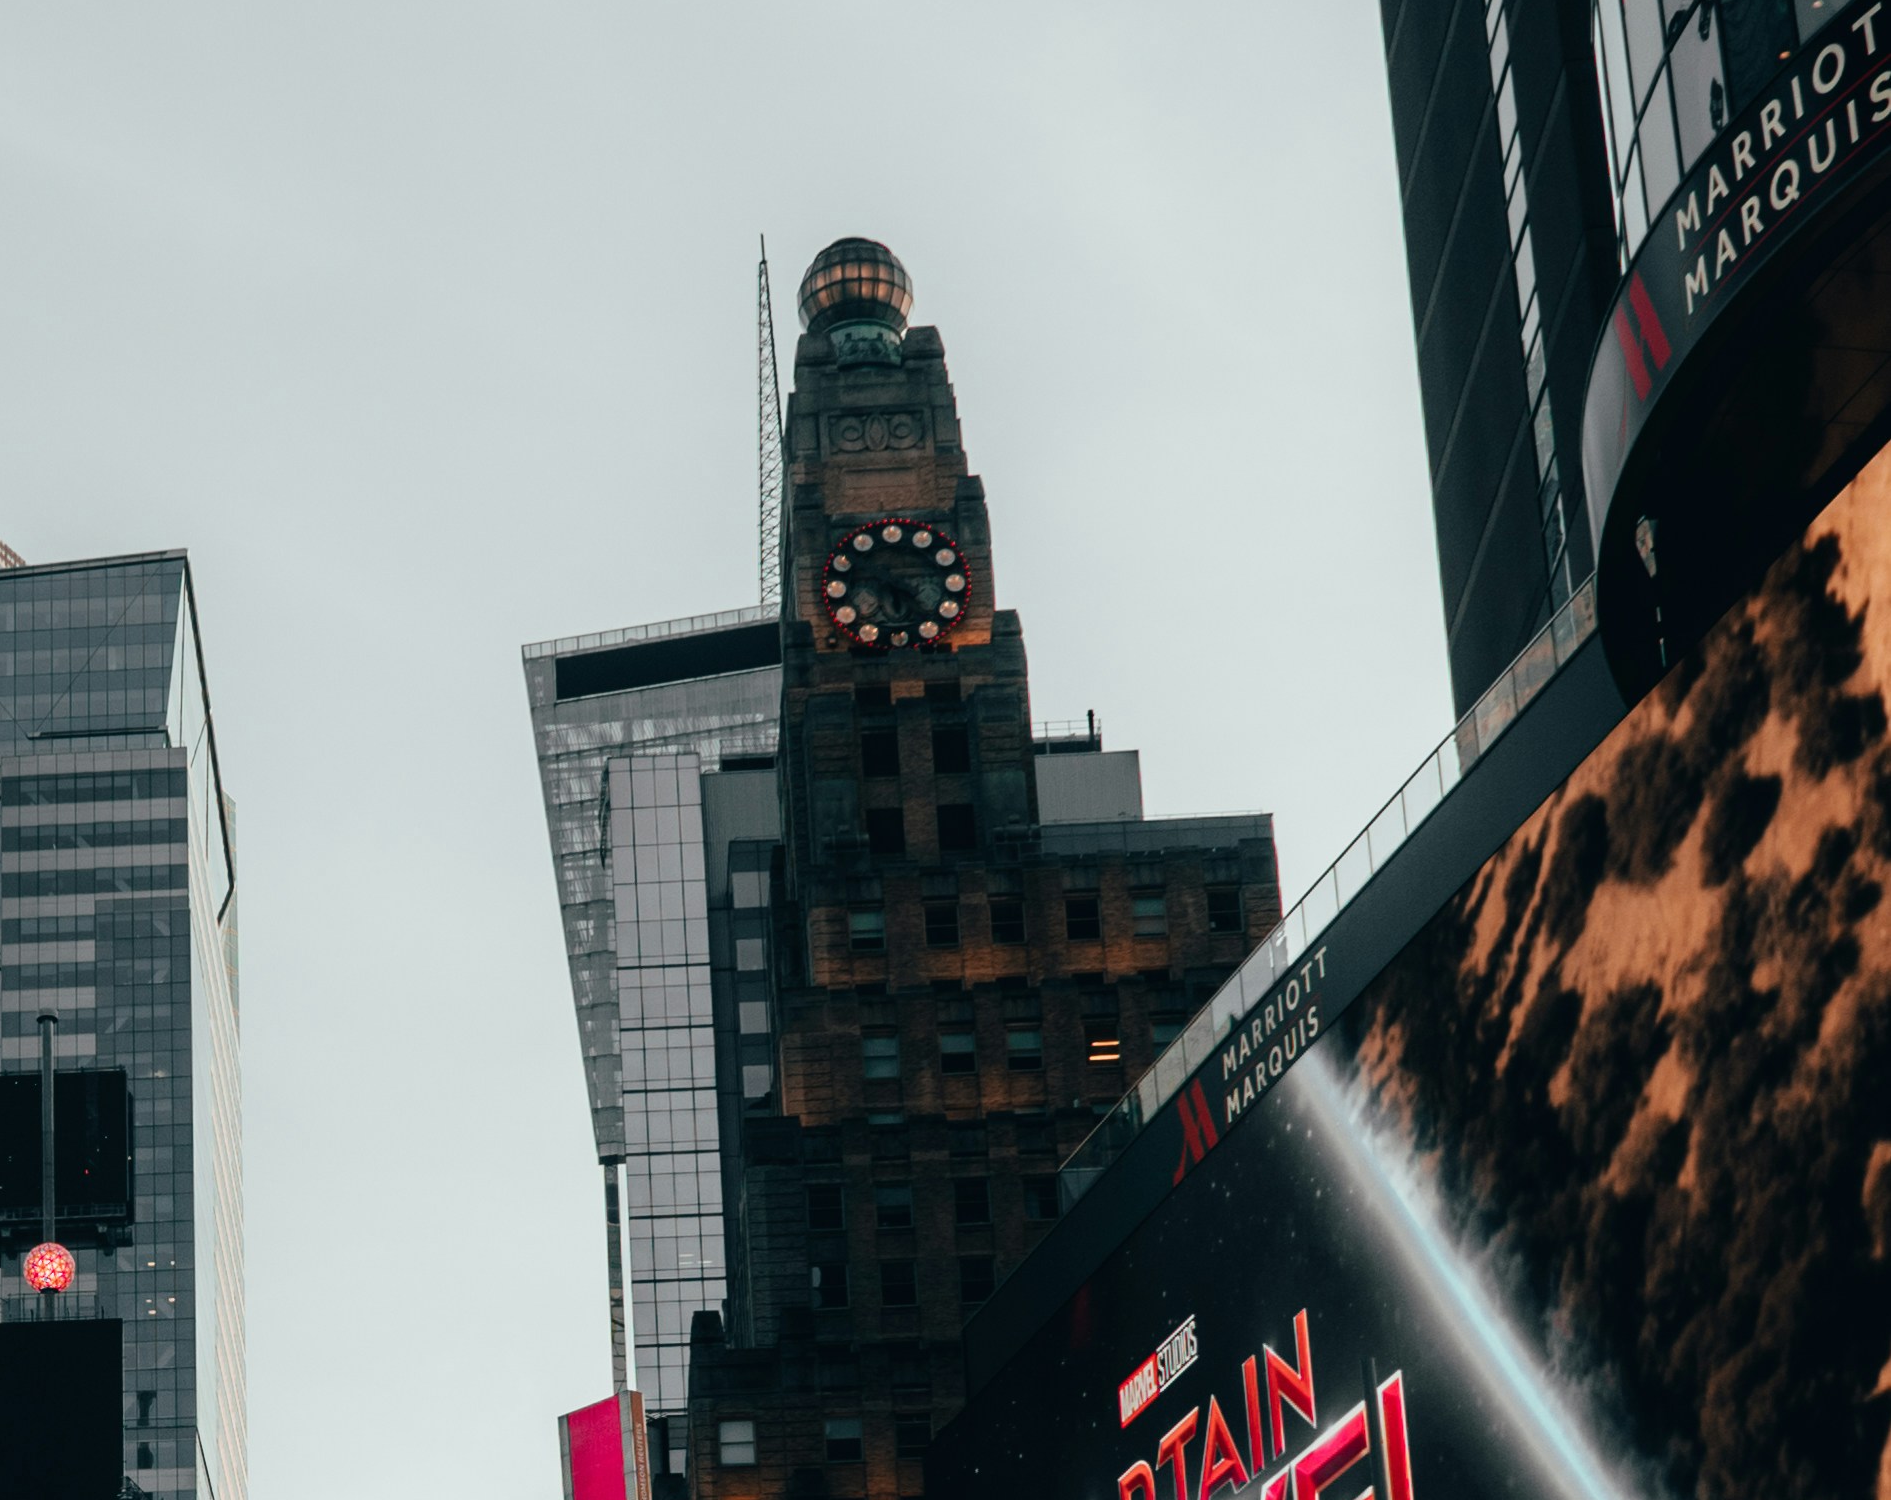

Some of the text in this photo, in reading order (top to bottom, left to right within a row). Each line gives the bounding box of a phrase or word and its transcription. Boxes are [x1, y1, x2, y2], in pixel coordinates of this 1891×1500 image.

[1685, 70, 1891, 316] MARQUIS
[1223, 946, 1327, 1080] MARRIOTT
[1226, 1005, 1319, 1123] MARQUIS
[1119, 1320, 1199, 1423] MARVEL STUDIOS
